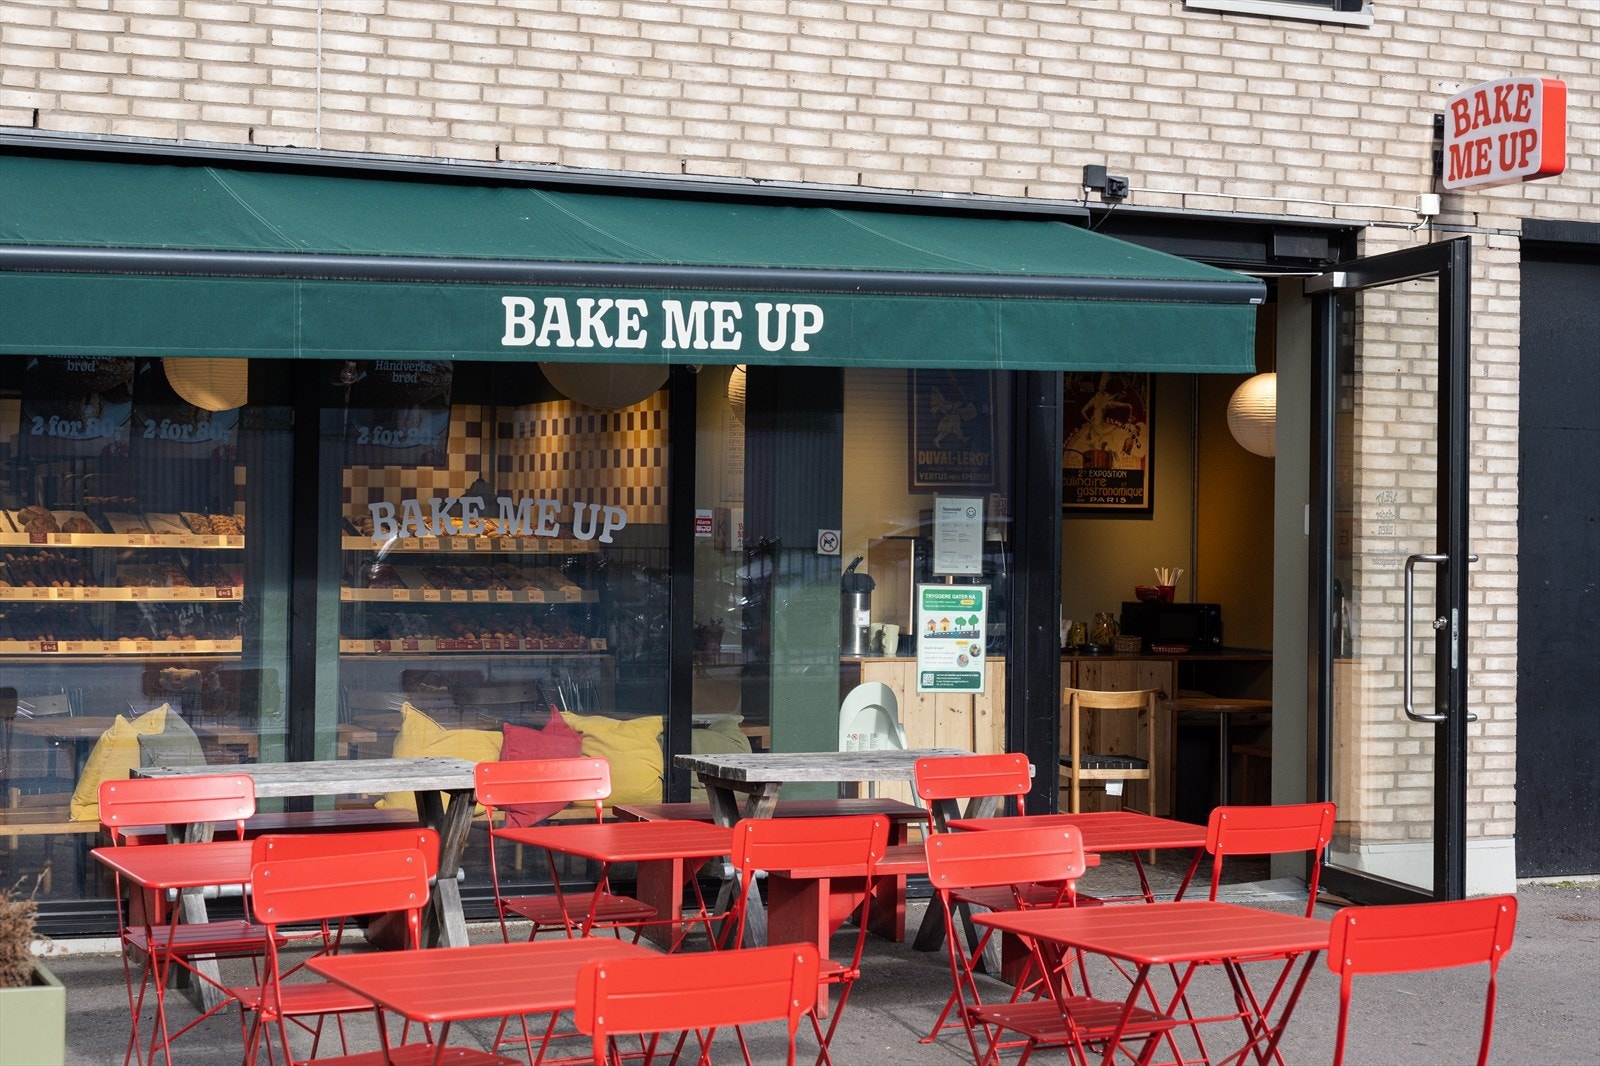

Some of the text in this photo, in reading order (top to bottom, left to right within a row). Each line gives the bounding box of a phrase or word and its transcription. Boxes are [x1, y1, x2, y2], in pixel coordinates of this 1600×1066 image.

[1450, 83, 1535, 138] BAKE
[1448, 128, 1538, 182] ME UP
[501, 296, 824, 352] BAKE ME UP
[31, 416, 44, 436] 2
[48, 416, 82, 437] for
[143, 420, 157, 439] 2
[159, 419, 193, 440] for
[357, 426, 370, 445] 2
[372, 426, 403, 445] for
[1089, 470, 1127, 478] EXPOSITION
[1076, 487, 1144, 499] gastronomique
[368, 496, 628, 544] BAKE ME UP
